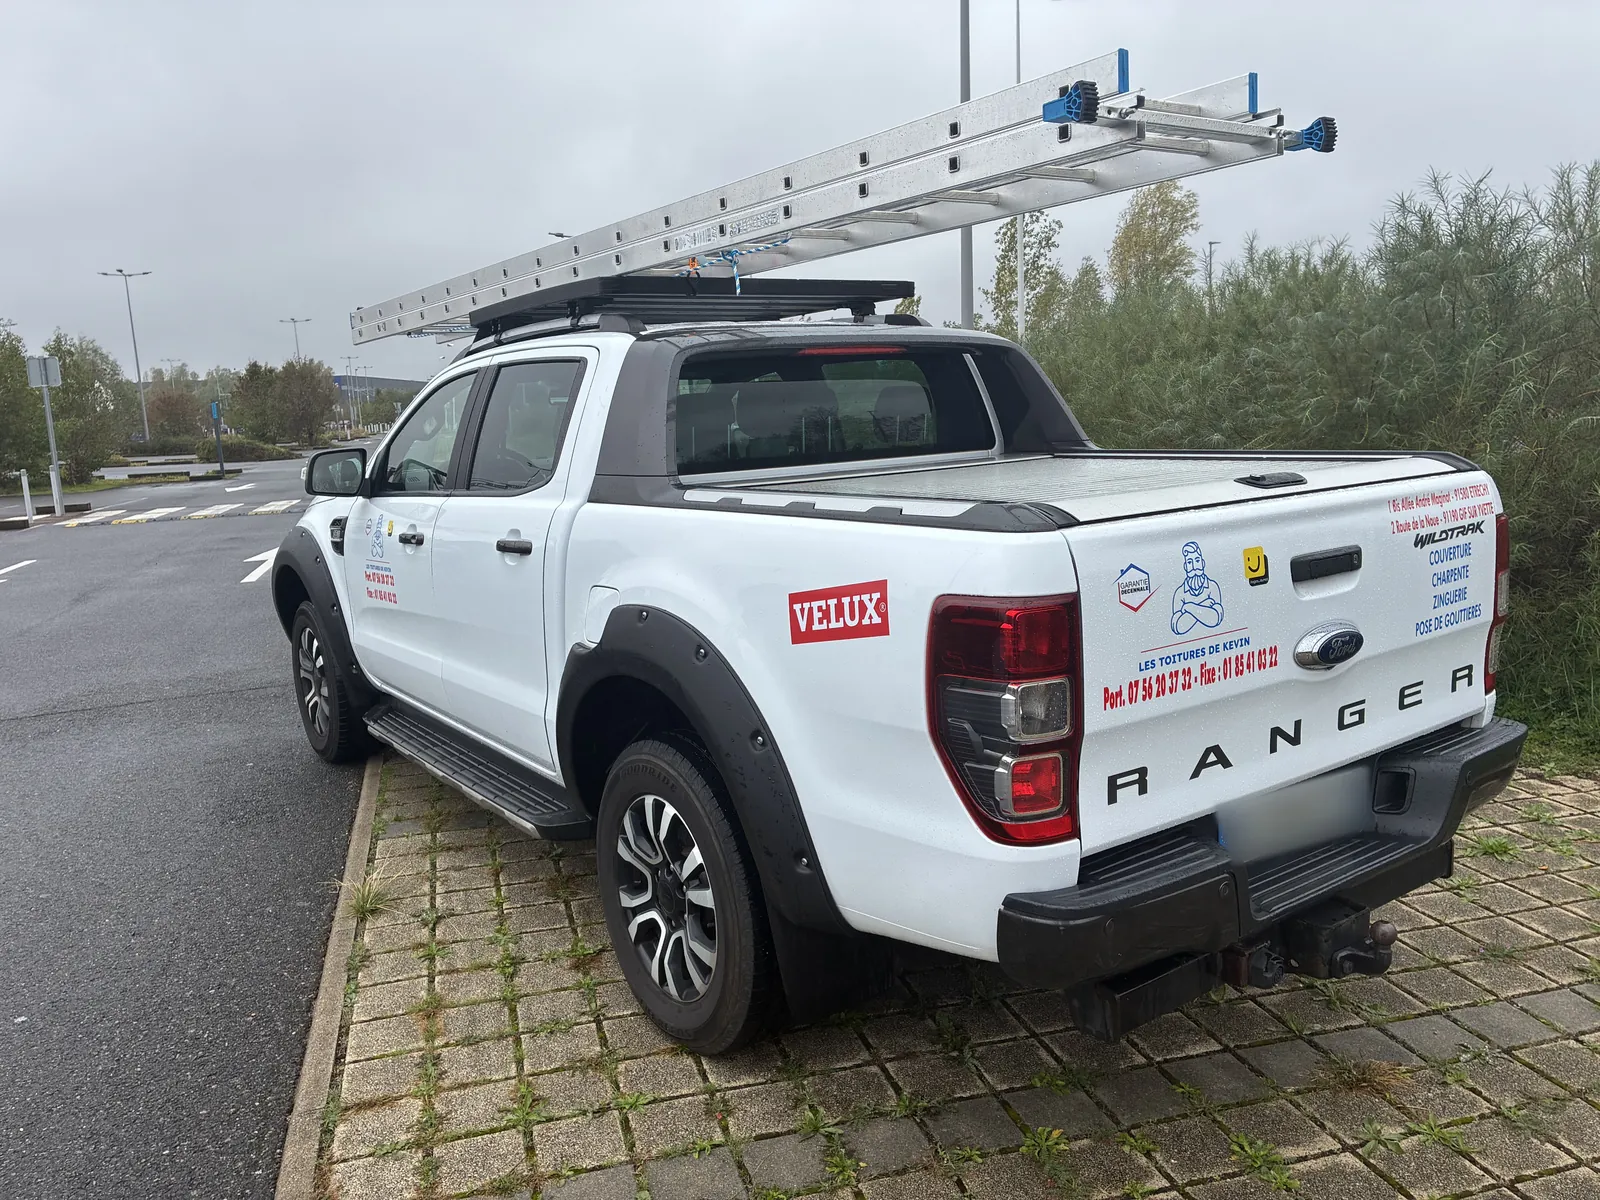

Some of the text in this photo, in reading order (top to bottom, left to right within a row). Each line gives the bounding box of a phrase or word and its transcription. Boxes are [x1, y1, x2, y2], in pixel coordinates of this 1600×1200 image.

[1401, 496, 1415, 511] Allée
[1415, 491, 1431, 509] André
[1391, 521, 1396, 535] 2
[1396, 518, 1411, 533] Route
[1411, 515, 1419, 531] de
[1419, 514, 1425, 529] la
[1442, 507, 1459, 524] 91190
[1467, 503, 1477, 519] SUR
[1476, 501, 1494, 517] YVETTE
[1413, 520, 1485, 550] WILDTRAK
[1429, 542, 1472, 566] COUVERTURE
[1120, 578, 1149, 590] GARANTIE
[1431, 564, 1470, 588] CHARPENTE
[1120, 585, 1149, 596] DECENNALE
[1432, 586, 1468, 610] ZINGUERIE
[1415, 603, 1482, 637] POSE DE GOUTTIERES
[1138, 636, 1251, 672] LES TOITURES DE KEVIN
[1328, 635, 1357, 660] Ford
[1103, 684, 1126, 711] Port.
[1128, 679, 1140, 705] 07
[1141, 676, 1153, 702] 56
[1155, 672, 1167, 699] 20
[1168, 669, 1180, 695] 37
[1181, 666, 1192, 692] 32
[1200, 660, 1216, 686] Fixe
[1222, 656, 1232, 681] 01
[1234, 653, 1245, 677] 85
[1246, 650, 1255, 674] 41
[1257, 647, 1267, 672] 03
[1268, 644, 1278, 668] 22
[1107, 664, 1474, 806] RANGER
